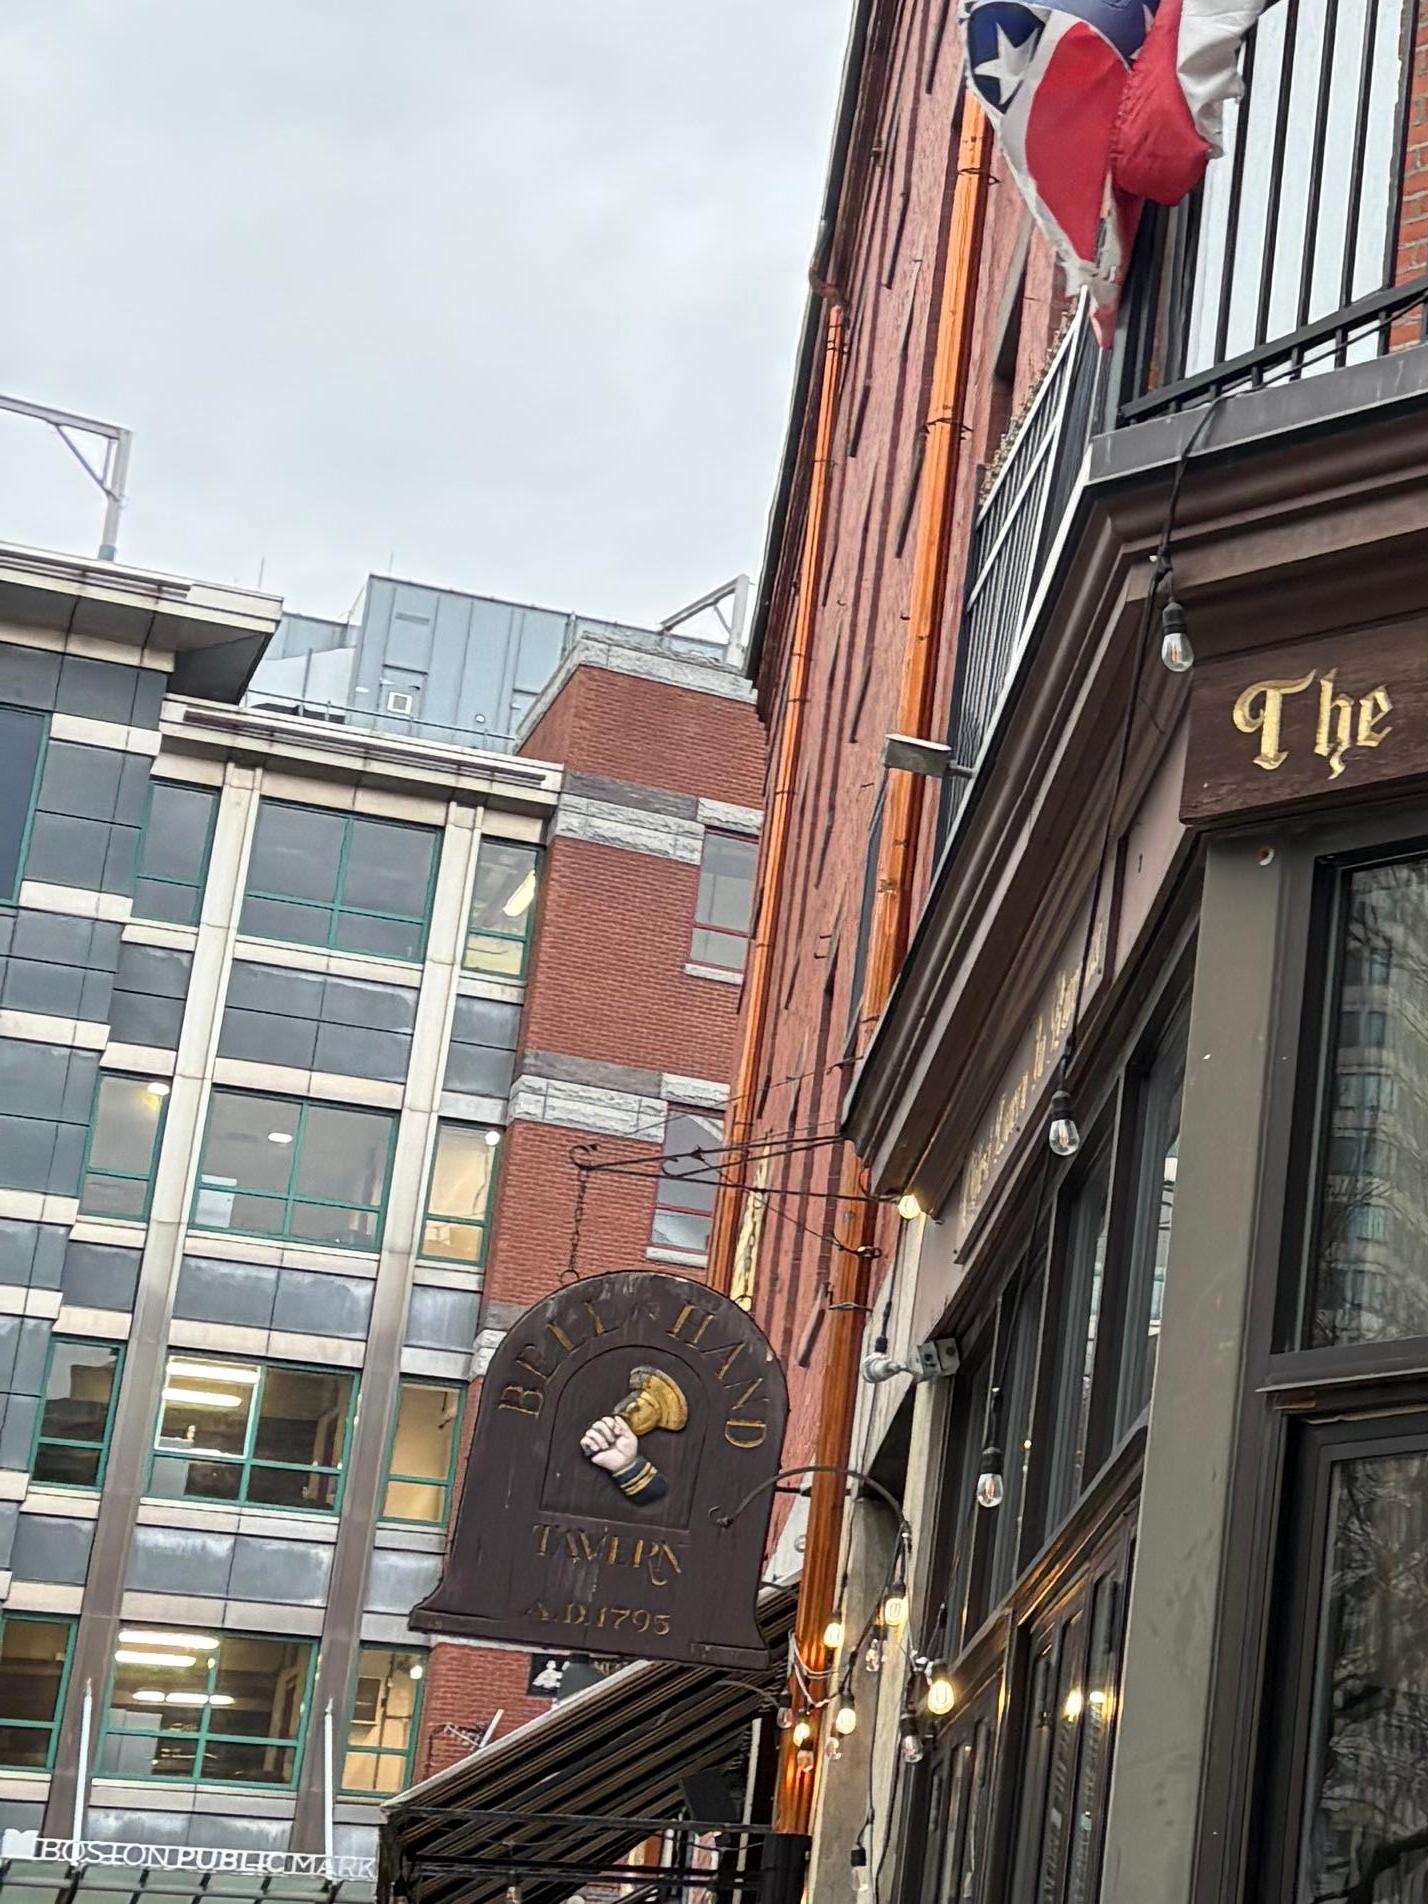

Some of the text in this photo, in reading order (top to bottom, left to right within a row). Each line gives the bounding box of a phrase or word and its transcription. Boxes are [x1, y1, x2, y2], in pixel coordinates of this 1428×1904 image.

[1233, 669, 1393, 780] The
[498, 1300, 620, 1419] BELL
[664, 1303, 770, 1449] HAND
[532, 1524, 688, 1586] TAVERN
[40, 1840, 376, 1880] BOSTON PUBLIC MARK
